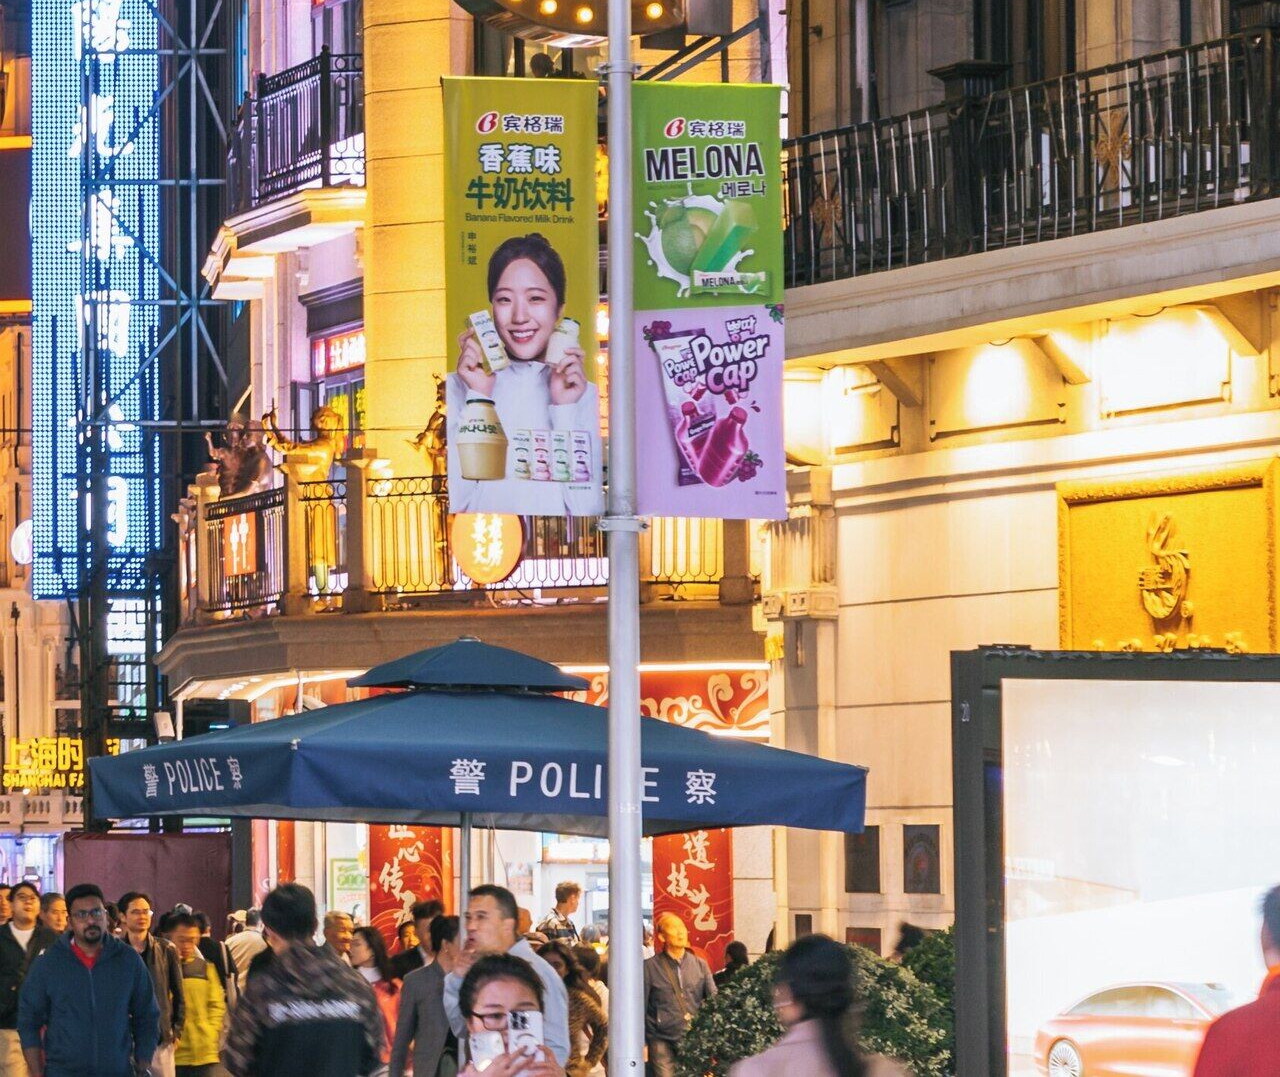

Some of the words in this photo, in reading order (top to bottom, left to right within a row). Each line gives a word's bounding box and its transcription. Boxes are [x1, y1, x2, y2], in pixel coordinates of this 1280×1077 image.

[502, 114, 564, 134] 宾格瑞
[478, 142, 562, 175] 香蕉味
[644, 143, 766, 183] MELONA
[465, 175, 575, 212] 牛奶饮料
[721, 181, 767, 198] 메로나
[465, 212, 497, 223] Banana
[498, 213, 534, 224] Flavored
[690, 333, 770, 373] Power
[2, 773, 67, 788] SHANGHAI
[164, 758, 224, 797] POLICE
[449, 758, 487, 796] 警
[509, 760, 660, 803] POLIE
[685, 768, 717, 805] 察
